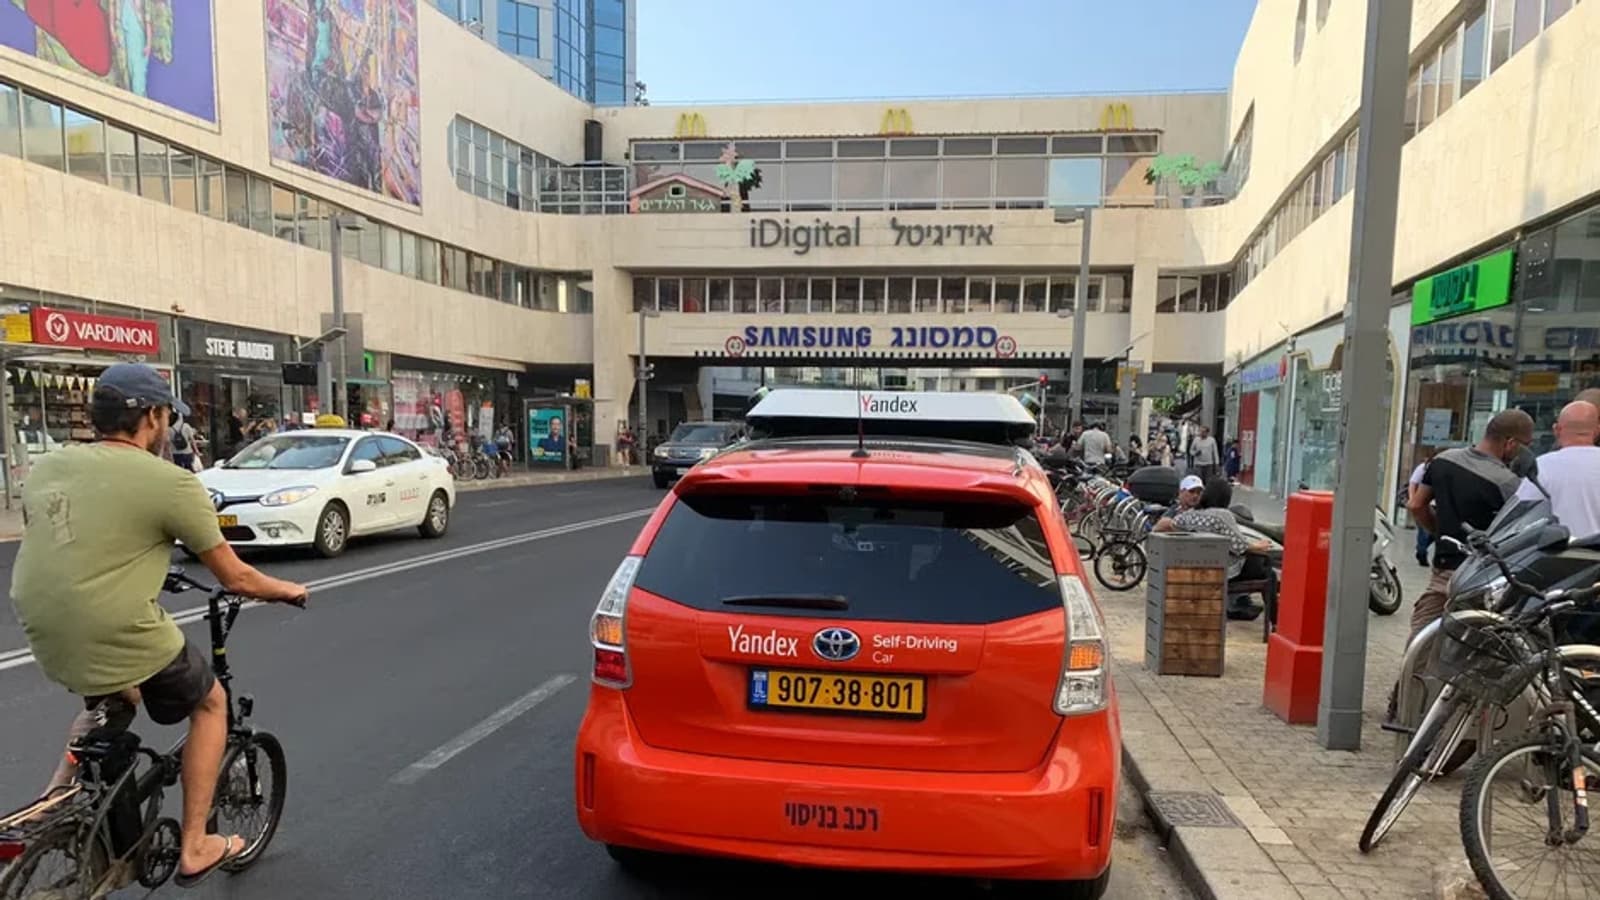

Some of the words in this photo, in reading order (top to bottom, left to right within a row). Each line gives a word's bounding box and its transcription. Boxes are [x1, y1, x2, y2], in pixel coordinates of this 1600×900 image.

[749, 216, 861, 255] iDigital
[891, 217, 994, 247] אידיגיטל
[74, 321, 153, 346] VARDINON
[744, 326, 872, 348] SAMSUNG
[890, 327, 997, 348] סמסונג
[206, 337, 236, 358] STEVE
[861, 396, 918, 413] Yandex
[728, 624, 798, 657] Yandex
[872, 634, 958, 652] Self-Driving
[872, 651, 894, 664] Car
[785, 802, 838, 829] בניסוי
[843, 806, 879, 832] רכב
